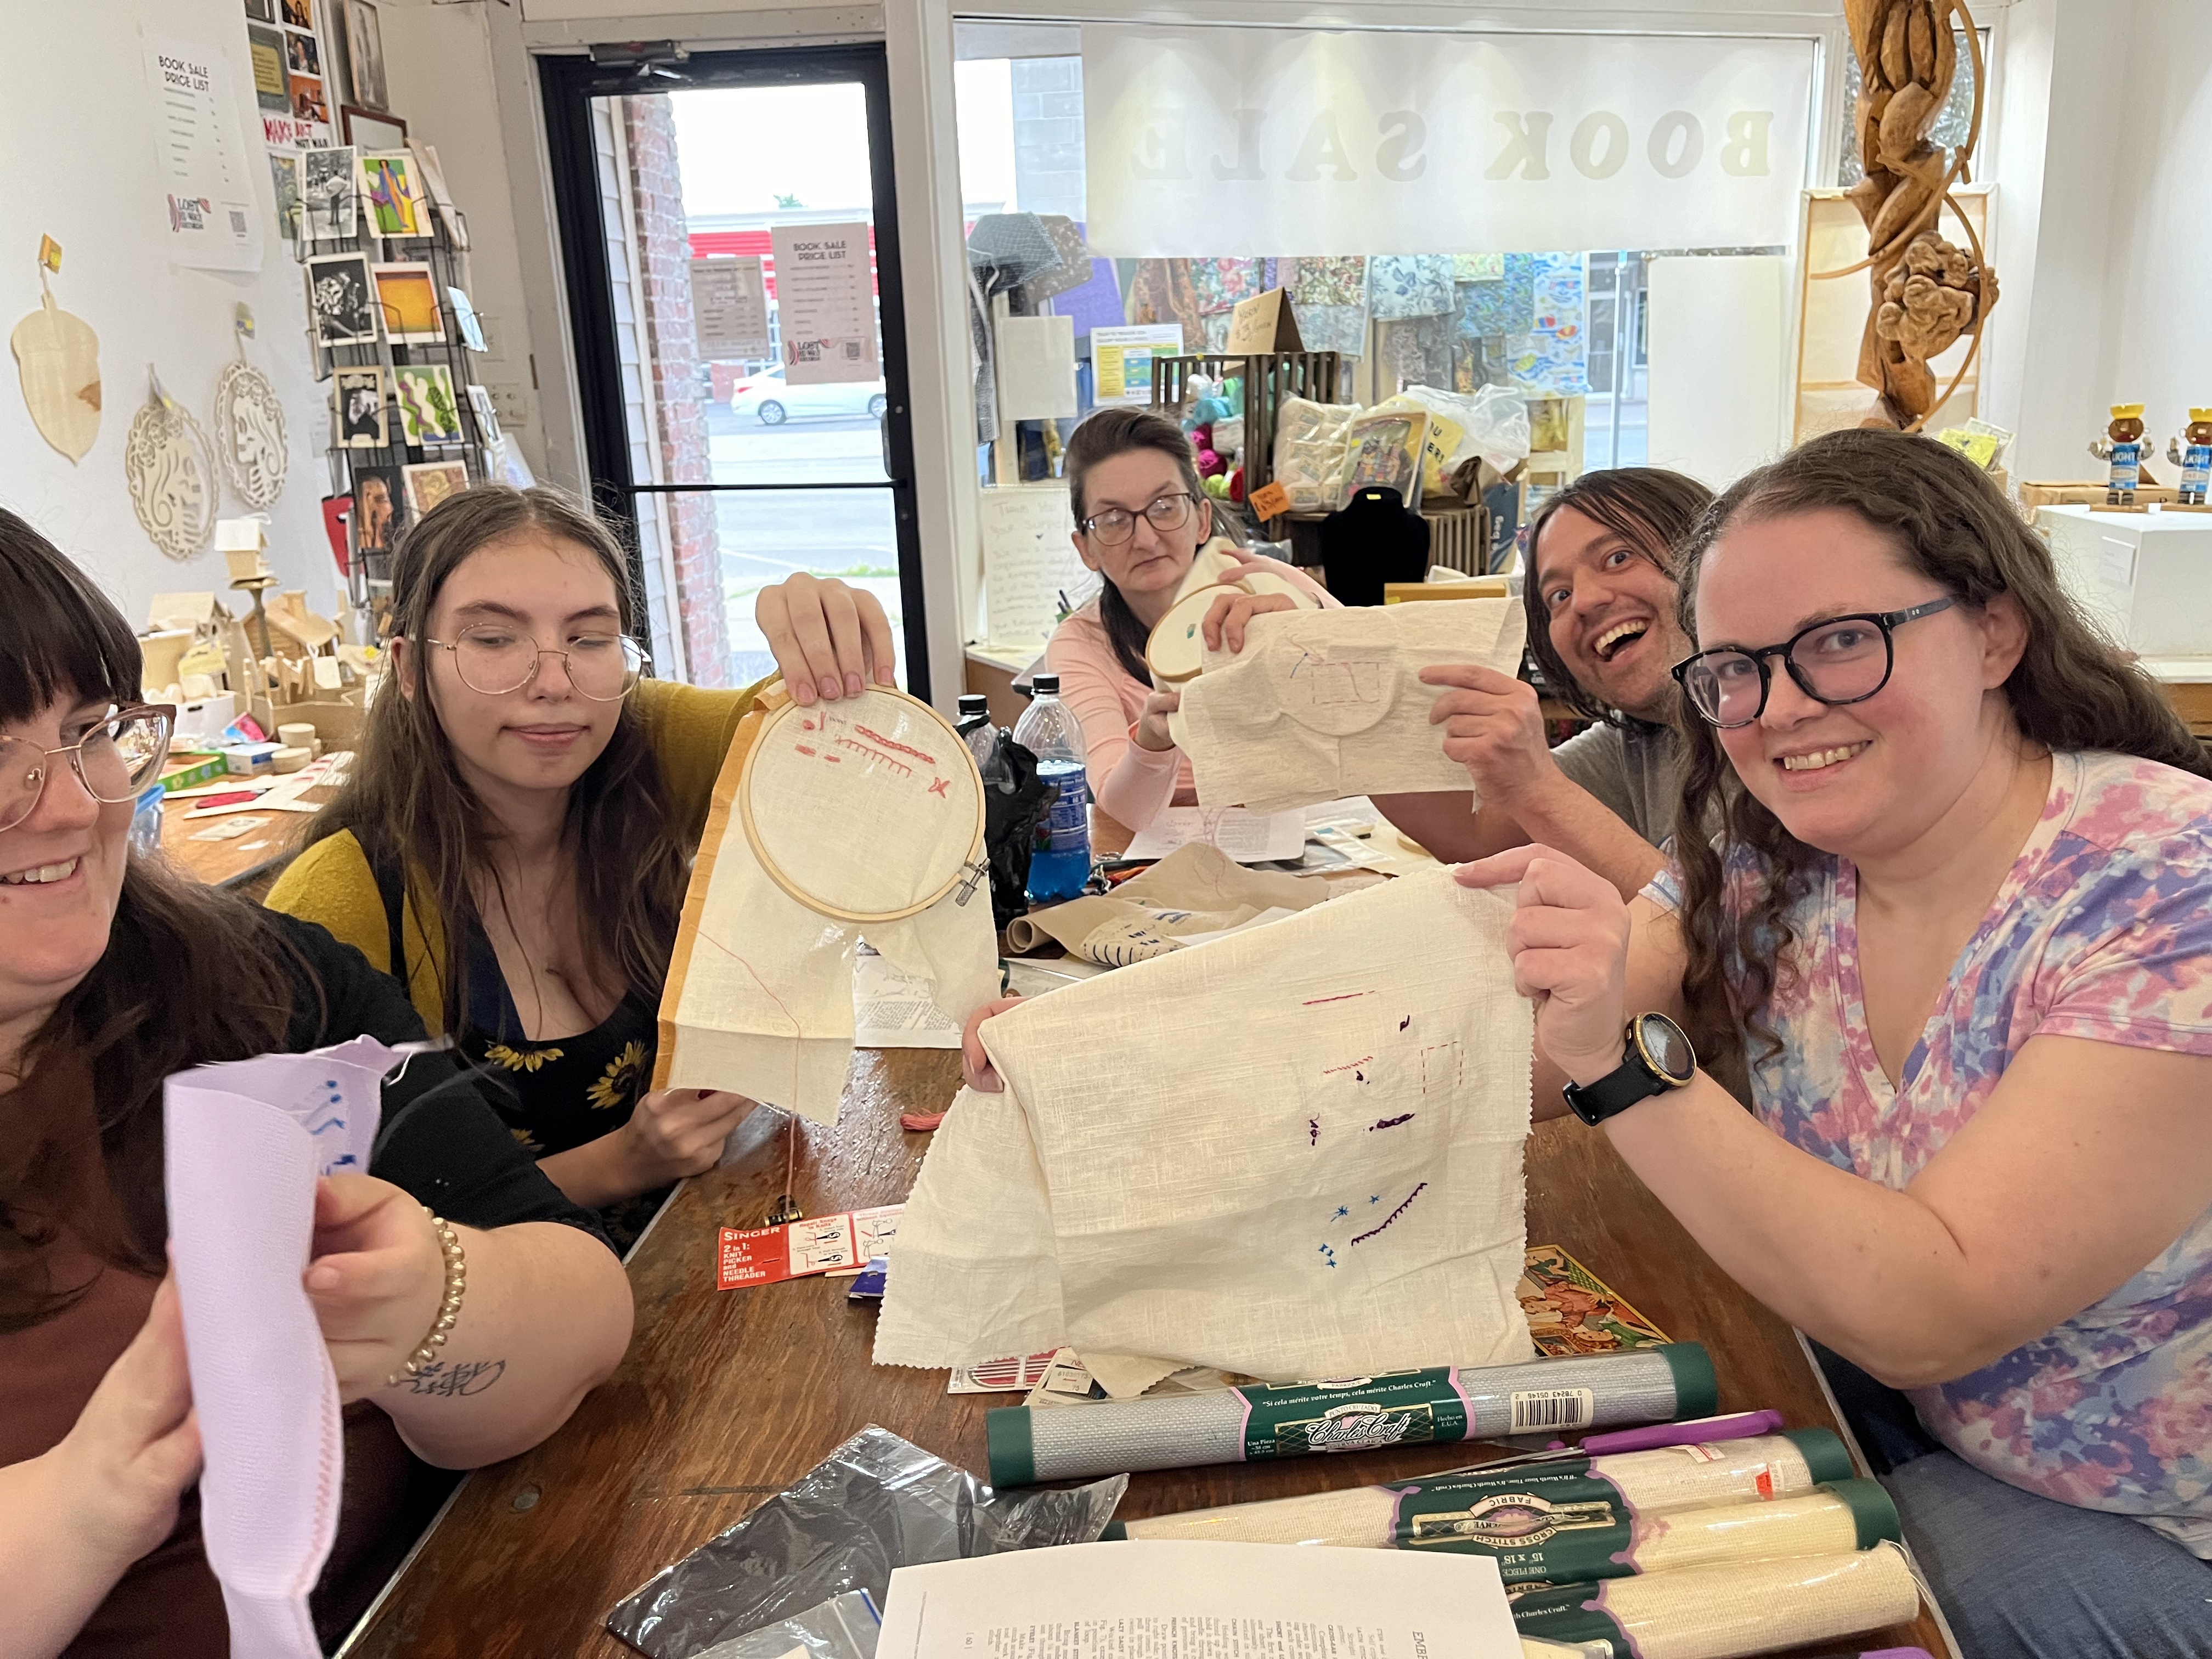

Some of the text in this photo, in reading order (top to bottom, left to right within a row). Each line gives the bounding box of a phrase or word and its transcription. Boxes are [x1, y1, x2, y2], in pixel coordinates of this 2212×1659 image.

[159, 55, 186, 72] BOOK
[794, 240, 847, 251] BOOK SALE
[798, 251, 846, 261] PRICE LIST
[724, 1227, 780, 1242] SINGER
[724, 1255, 752, 1265] PICKER
[723, 1266, 754, 1277] NEEDLE
[723, 1271, 766, 1282] THREADER
[1366, 1386, 1387, 1395] mérite
[1329, 1404, 1378, 1418] PUNTO CRUZADO
[1305, 1412, 1412, 1445] Charles Craft
[1488, 1496, 1531, 1506] FABRIC
[1476, 1529, 1553, 1546] CROSS STITCH
[1502, 1567, 1528, 1577] PIECE
